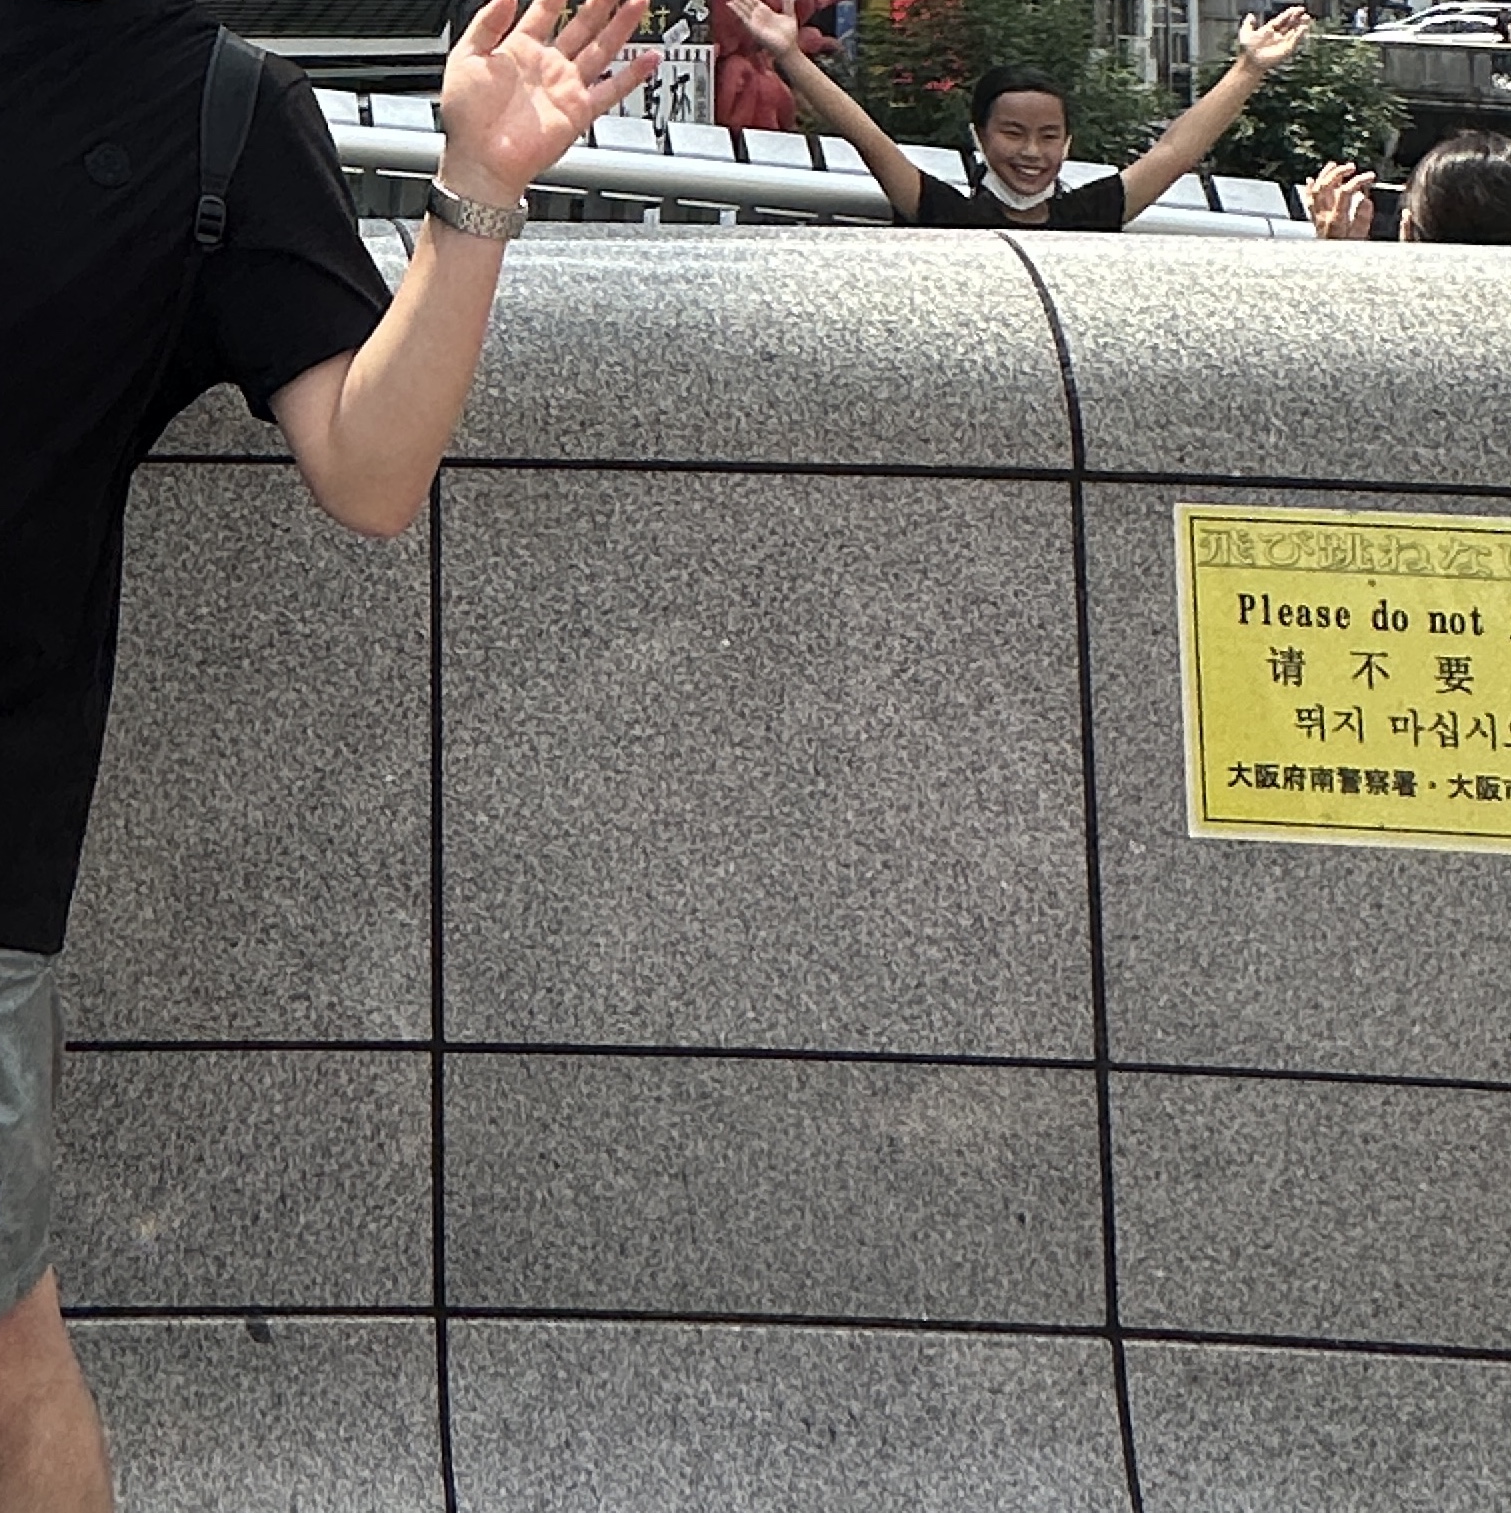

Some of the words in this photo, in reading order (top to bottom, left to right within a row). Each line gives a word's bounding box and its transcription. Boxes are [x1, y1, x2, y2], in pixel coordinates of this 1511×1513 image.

[1237, 593, 1352, 630] Please
[1371, 598, 1410, 633] do
[1428, 605, 1486, 637] not
